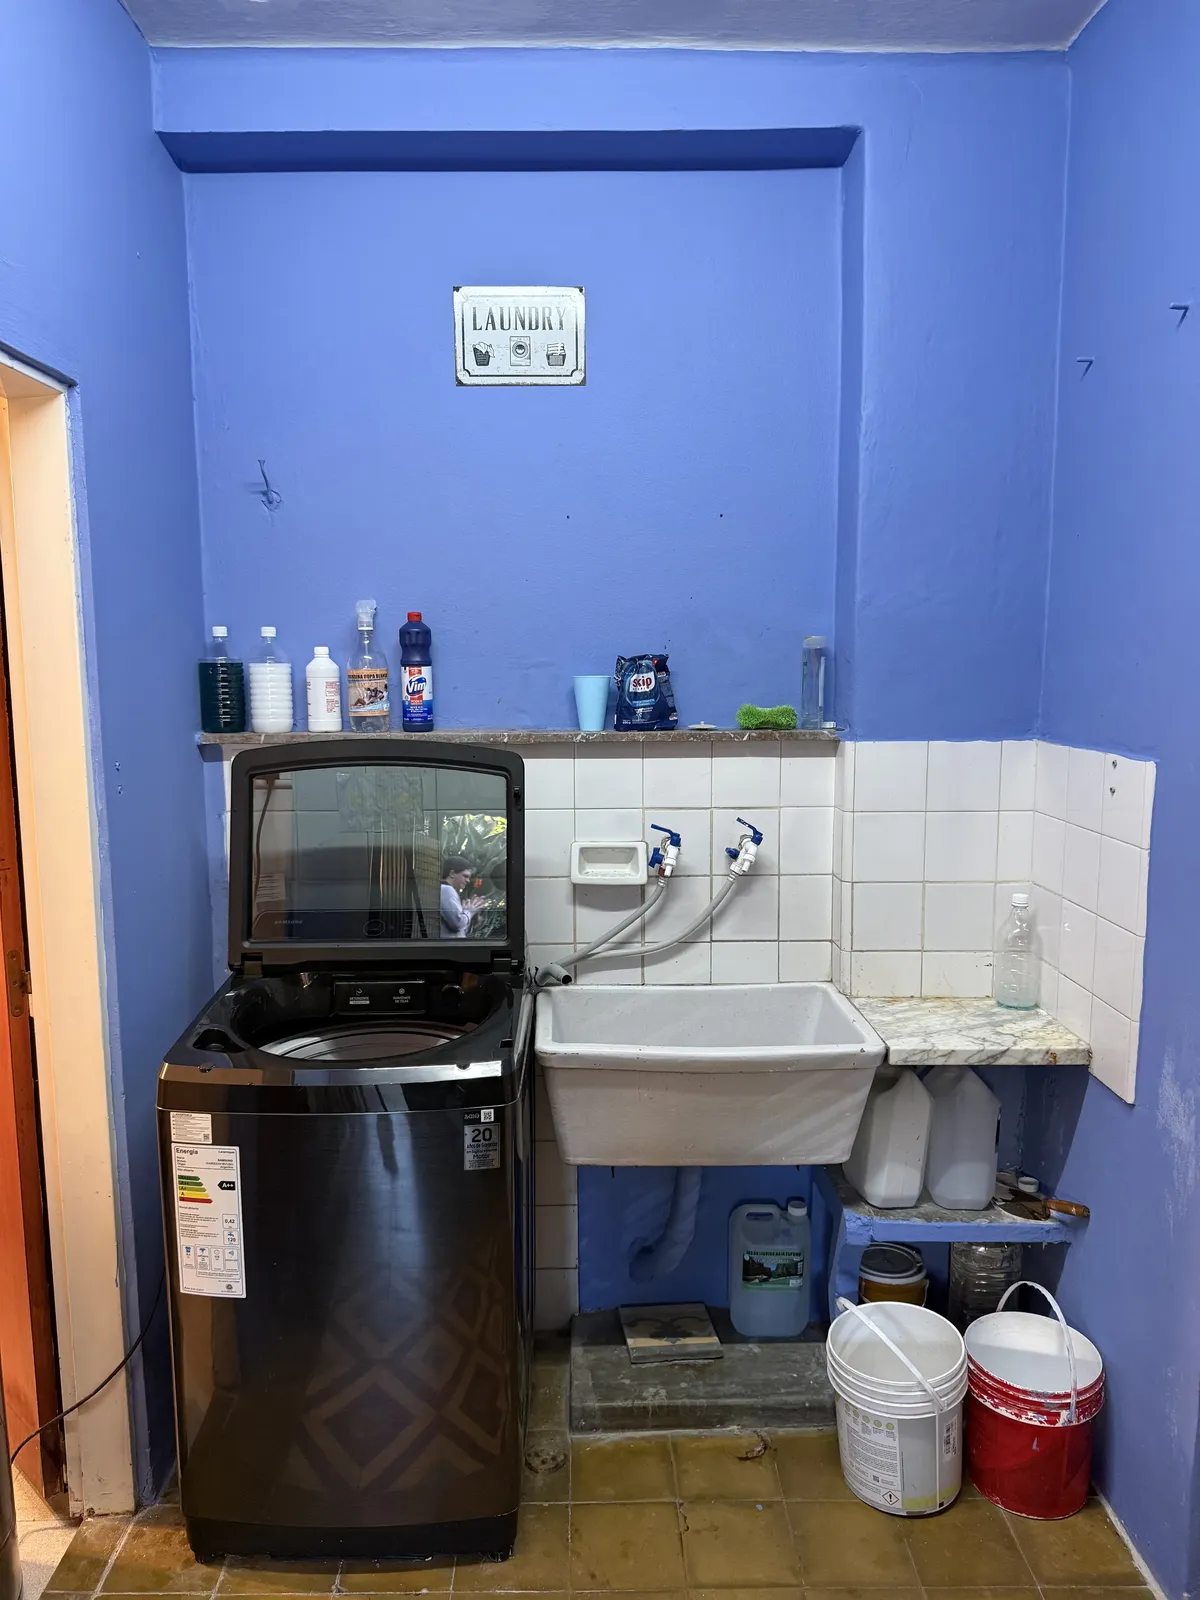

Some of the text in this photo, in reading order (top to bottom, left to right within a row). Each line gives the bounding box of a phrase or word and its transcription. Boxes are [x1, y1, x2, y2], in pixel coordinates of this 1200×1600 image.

[472, 306, 566, 330] LAUNDRY
[406, 681, 426, 693] Vim
[633, 676, 652, 688] skip
[472, 1128, 492, 1142] 20
